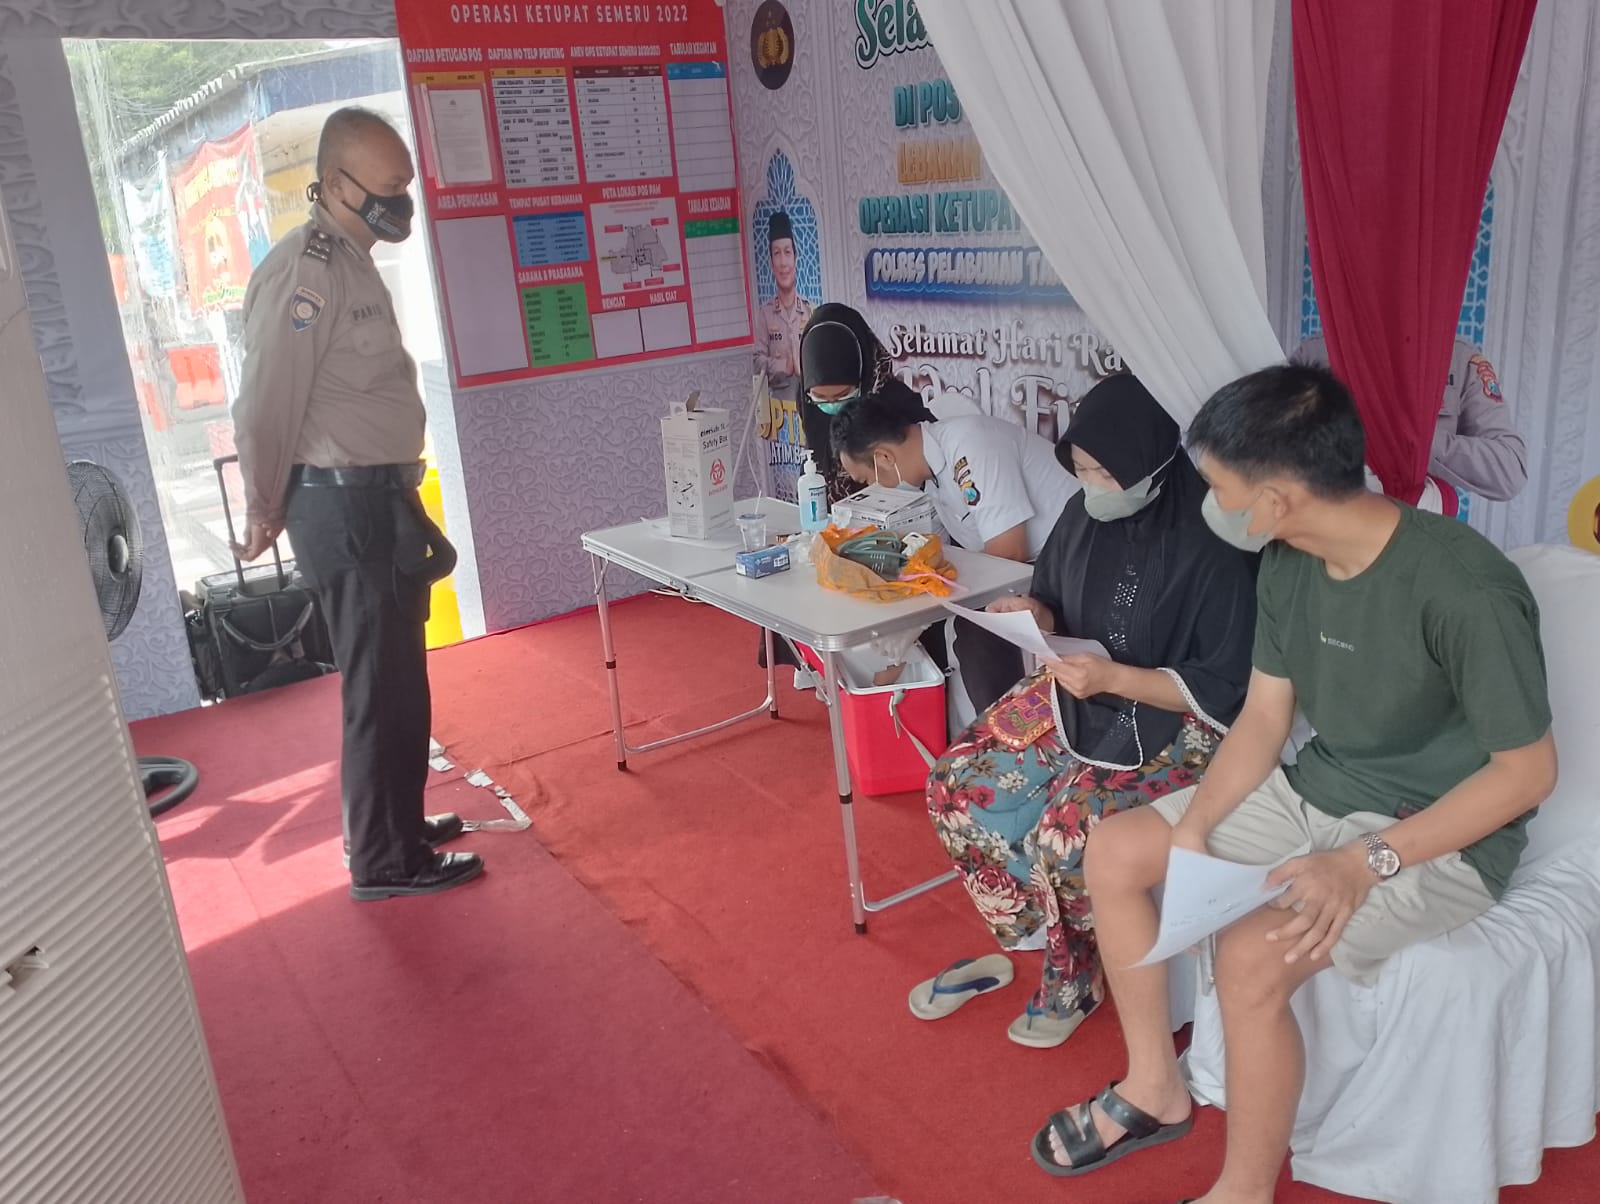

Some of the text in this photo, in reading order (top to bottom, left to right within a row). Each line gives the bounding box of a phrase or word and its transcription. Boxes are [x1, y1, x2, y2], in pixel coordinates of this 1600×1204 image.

[450, 4, 688, 23] OPERASI KETUPAT SEMERU 2022
[407, 48, 482, 62] DAFTAR PETUGAS POS
[488, 46, 565, 60] DAFTAR NO TELP PENTING
[894, 79, 960, 127] DI POS
[438, 192, 498, 209] AREA PENUGASAN
[616, 187, 637, 197] LOKASI
[859, 194, 930, 234] OPERASI
[518, 270, 543, 283] SARANA
[549, 266, 584, 280] PRASARANA
[872, 251, 926, 283] POLRES
[928, 250, 1023, 285] PELABUHAN
[889, 323, 987, 358] Selamat
[992, 319, 1062, 364] Hari
[702, 438, 718, 450] Safety
